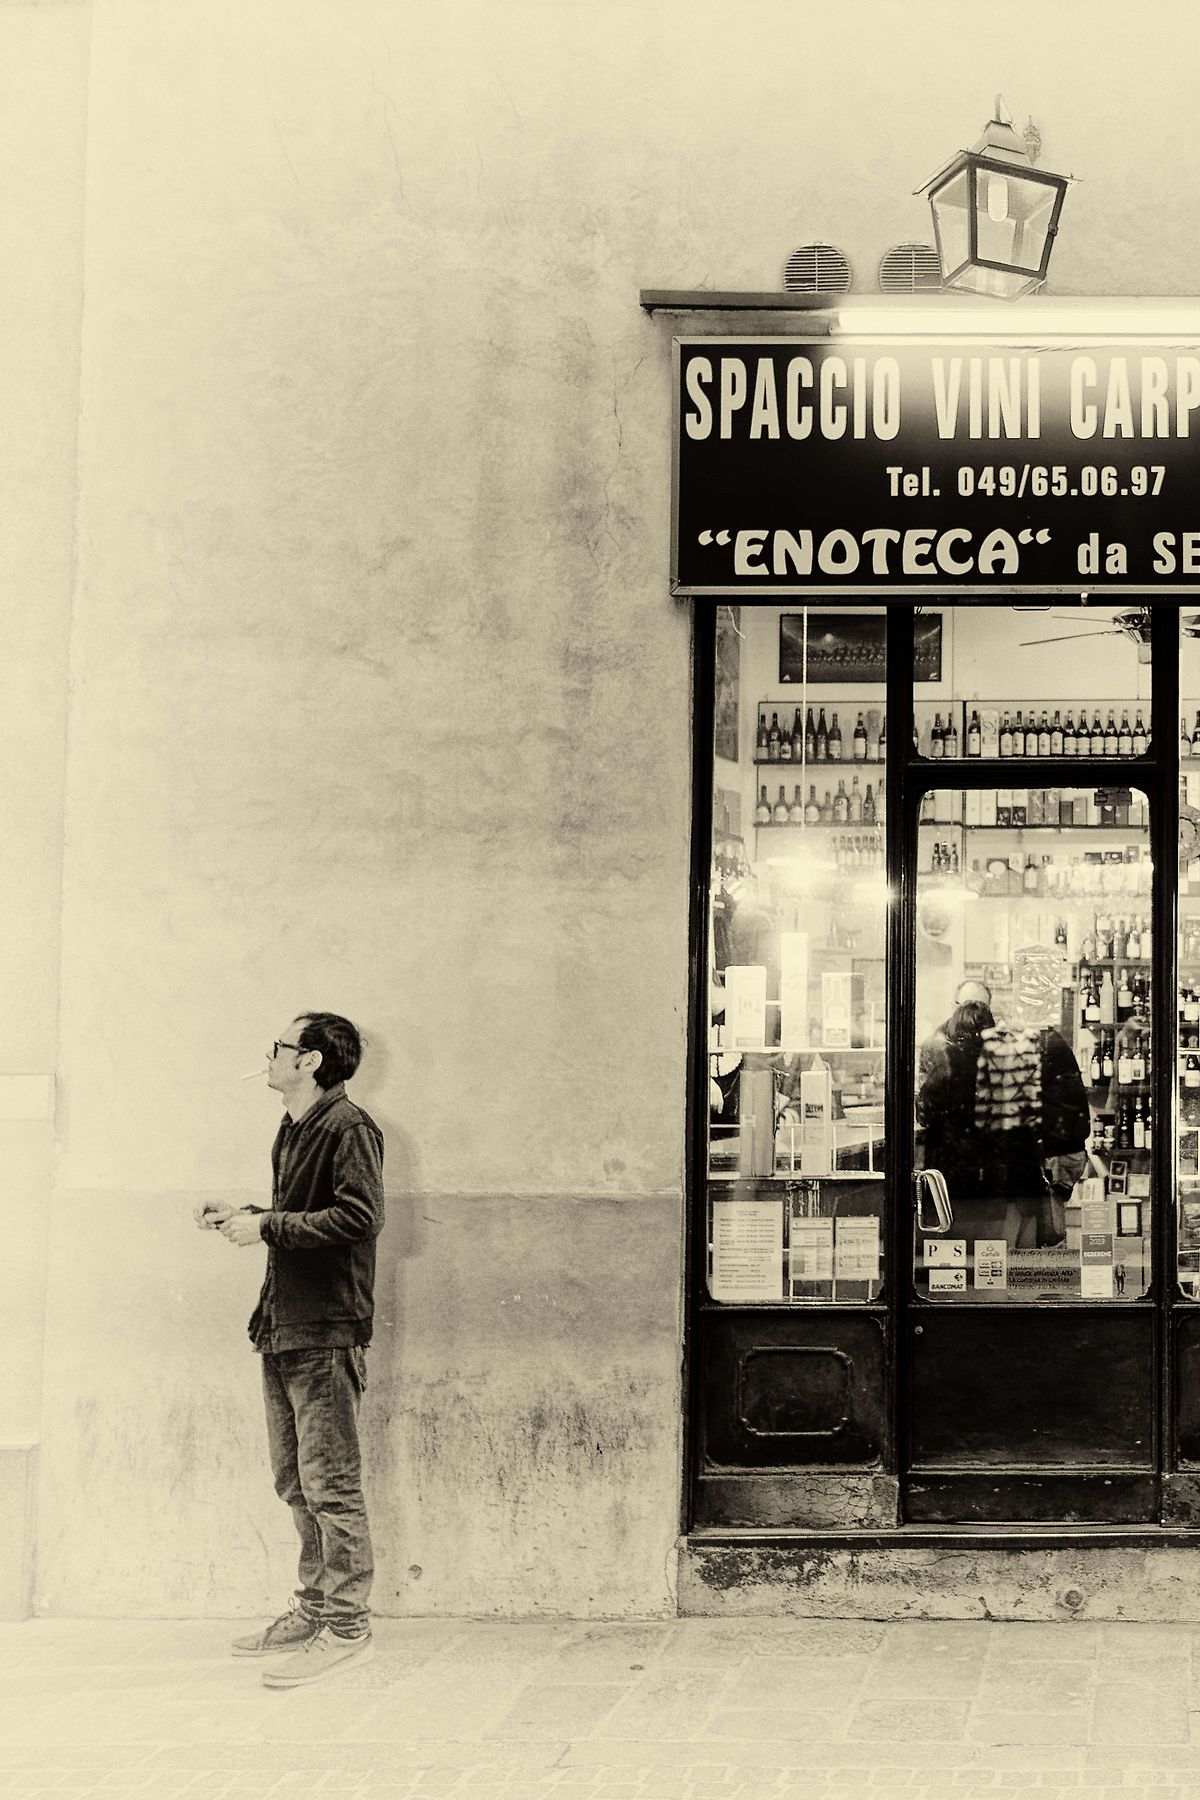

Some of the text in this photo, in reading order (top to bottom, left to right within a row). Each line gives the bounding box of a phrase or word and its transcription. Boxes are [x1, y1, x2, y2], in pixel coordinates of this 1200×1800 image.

[685, 356, 900, 441] SPACCIO
[932, 358, 1041, 441] VINI
[886, 464, 1166, 498] Tel. 049/65.06.97
[1077, 532, 1128, 575] da
